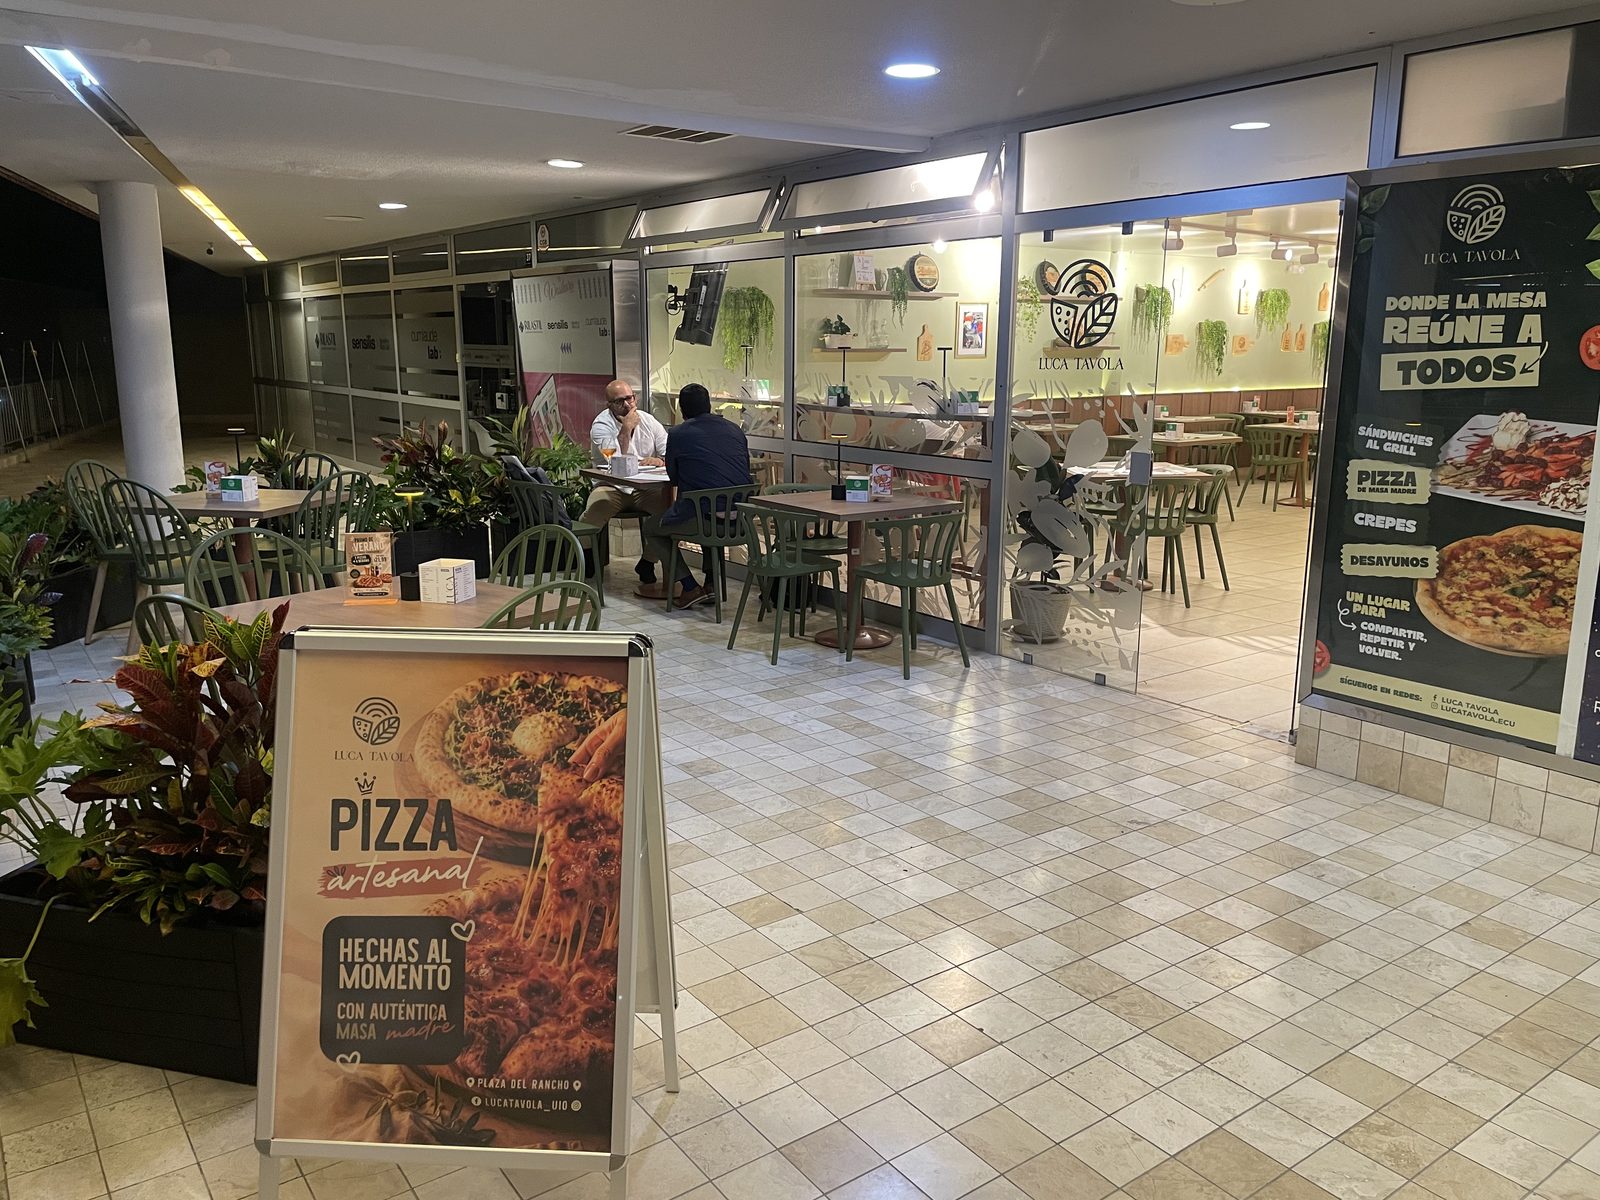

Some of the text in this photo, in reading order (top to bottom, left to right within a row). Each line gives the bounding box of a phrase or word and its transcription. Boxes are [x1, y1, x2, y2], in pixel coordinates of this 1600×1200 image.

[1424, 249, 1521, 265] LUCA TAVOLA
[1385, 291, 1547, 311] DONDE LA MESA
[1382, 314, 1543, 344] REÚNE A
[1039, 357, 1124, 370] LUCA TAVOLA
[1397, 354, 1517, 385] TODOS
[1358, 424, 1434, 447] SÁNDWICHES
[1365, 439, 1416, 456] AL GRILL
[1357, 470, 1417, 487] PIZZA
[1354, 512, 1418, 533] CREPES
[352, 541, 386, 552] VERANO
[1350, 555, 1429, 568] DESAYUNOS
[1346, 591, 1411, 612] UN LUGAR
[1352, 603, 1386, 619] PARA
[1359, 632, 1416, 651] REPETIR Y
[1360, 621, 1428, 643] COMPARTIR,
[1358, 644, 1403, 661] VOLVER.
[1339, 675, 1423, 702] SÍGUENOS EN REDES:
[1440, 704, 1516, 728] LUCATAVOLA.ECU
[1441, 696, 1500, 716] LUCA TAVOLA
[334, 750, 415, 762] LUCA TAVOLA
[330, 798, 458, 851] PIZZA
[326, 835, 484, 894] artesanal
[339, 937, 452, 963] HECHAS AL
[338, 963, 451, 991] MOMENTO
[337, 999, 447, 1021] CON AUTÉNTICA
[336, 1019, 456, 1041] MASA madre
[477, 1078, 570, 1090] PLAZA DEL RANCHO
[485, 1097, 568, 1112] LUCATAVOLA_UIO
